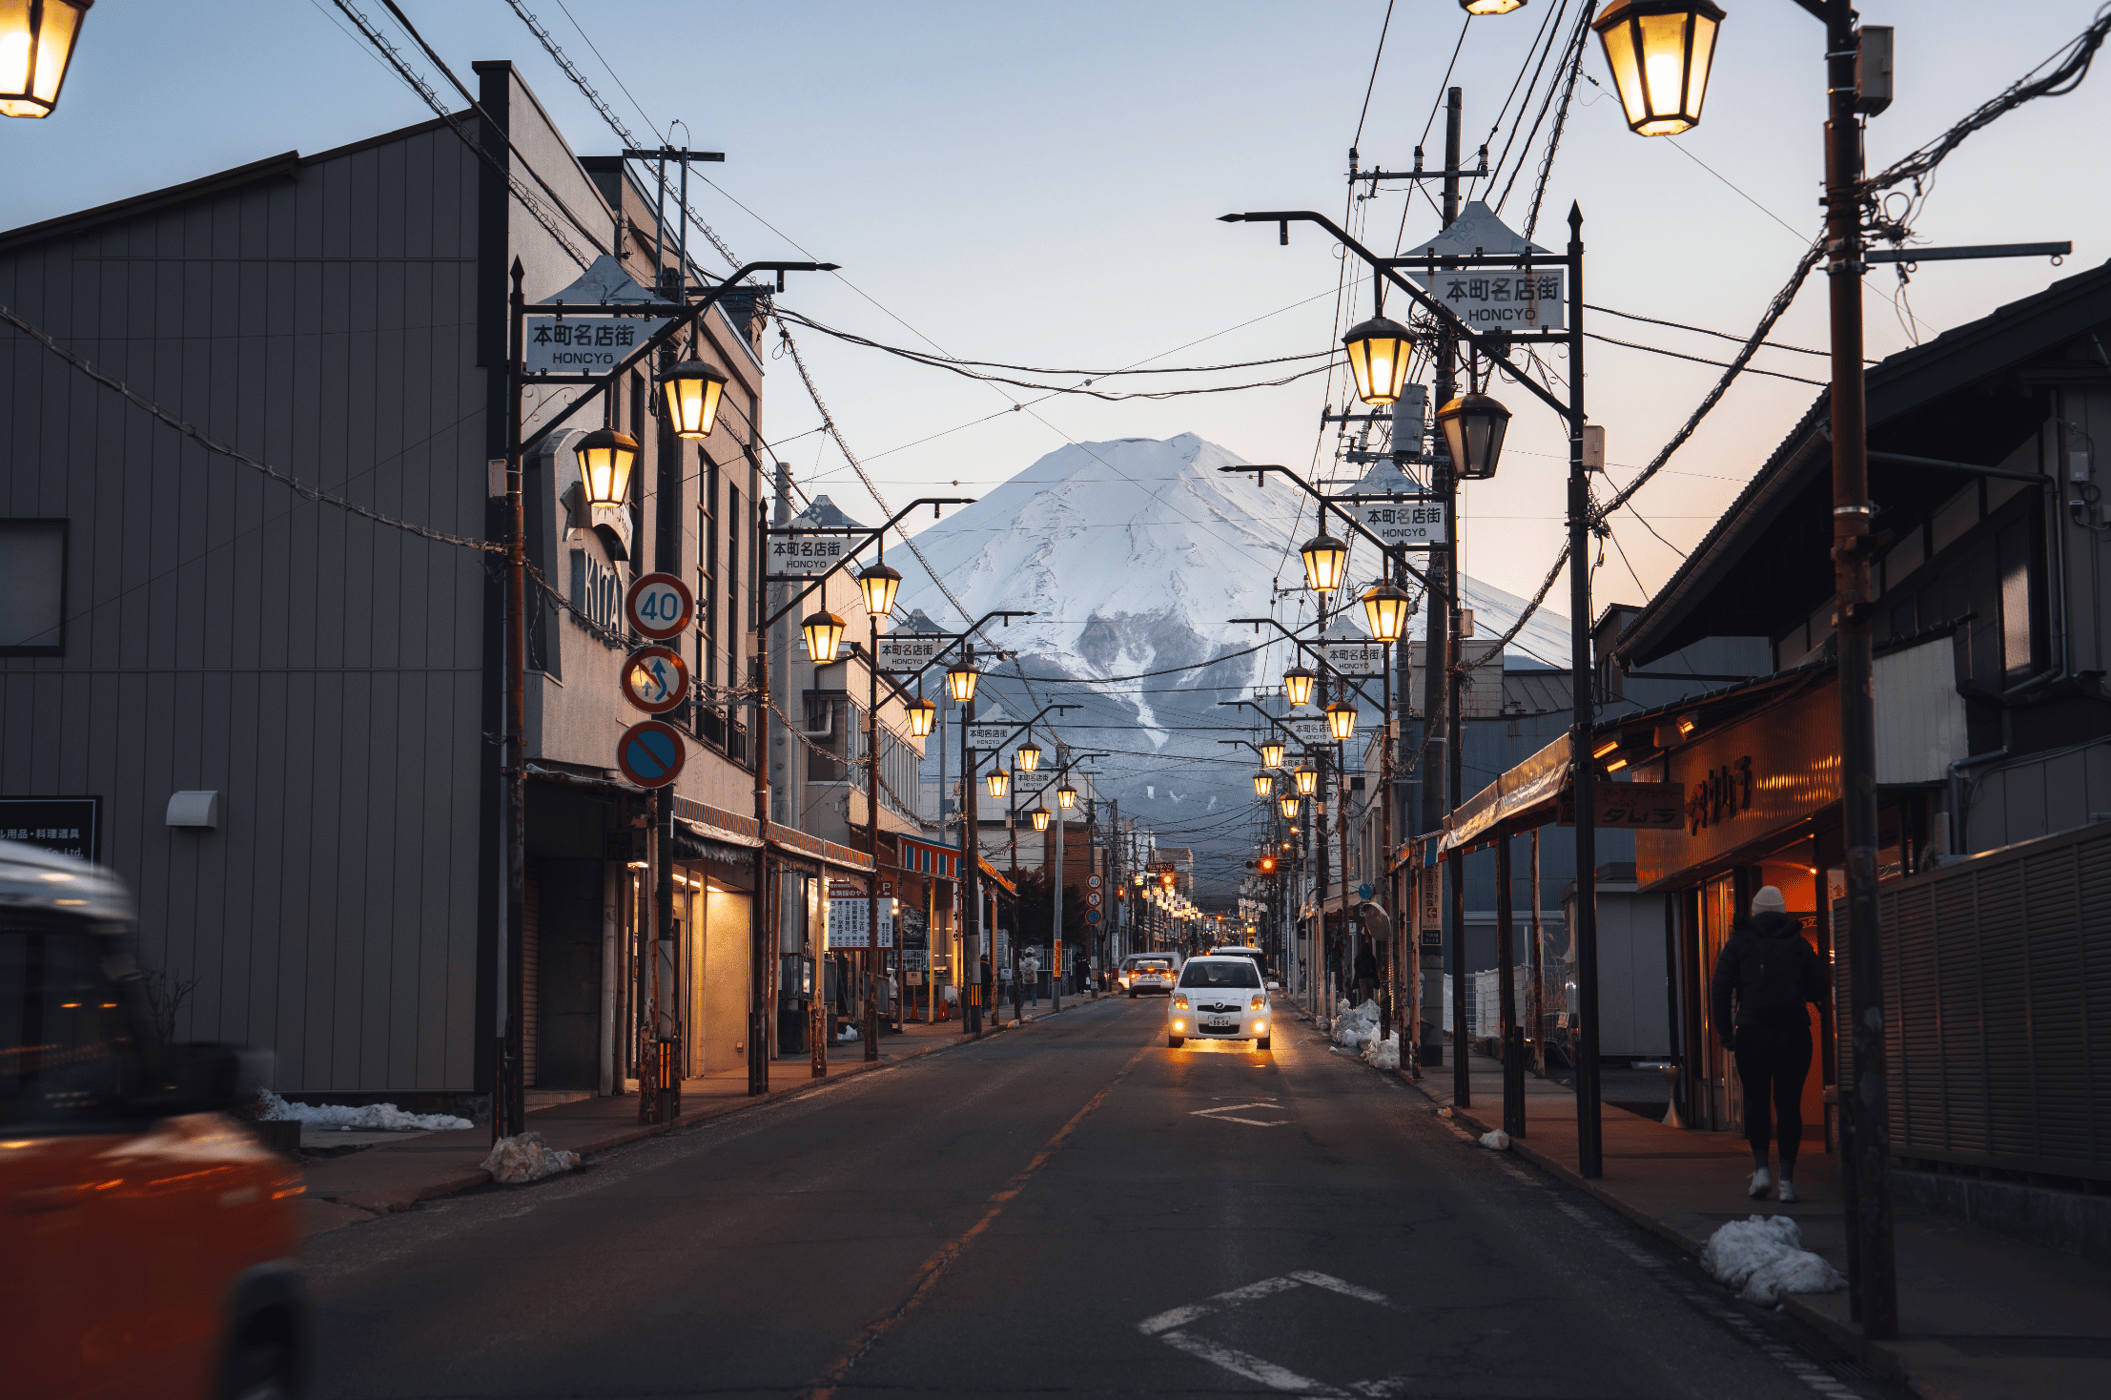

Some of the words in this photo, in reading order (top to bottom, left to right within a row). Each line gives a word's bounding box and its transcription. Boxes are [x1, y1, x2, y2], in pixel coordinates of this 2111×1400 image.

[1446, 276, 1558, 302] 本町名店街
[533, 324, 634, 346] 本町名店街
[1368, 507, 1441, 525] 本町名店街
[773, 541, 840, 556] 本町名店街
[641, 592, 678, 621] 40
[882, 644, 933, 655] 本町名店街
[1329, 649, 1379, 660] 本町名店街
[969, 729, 1007, 738] 本町名店街
[1602, 808, 1676, 823] タムラ
[882, 882, 891, 892] P
[1090, 878, 1099, 886] 40
